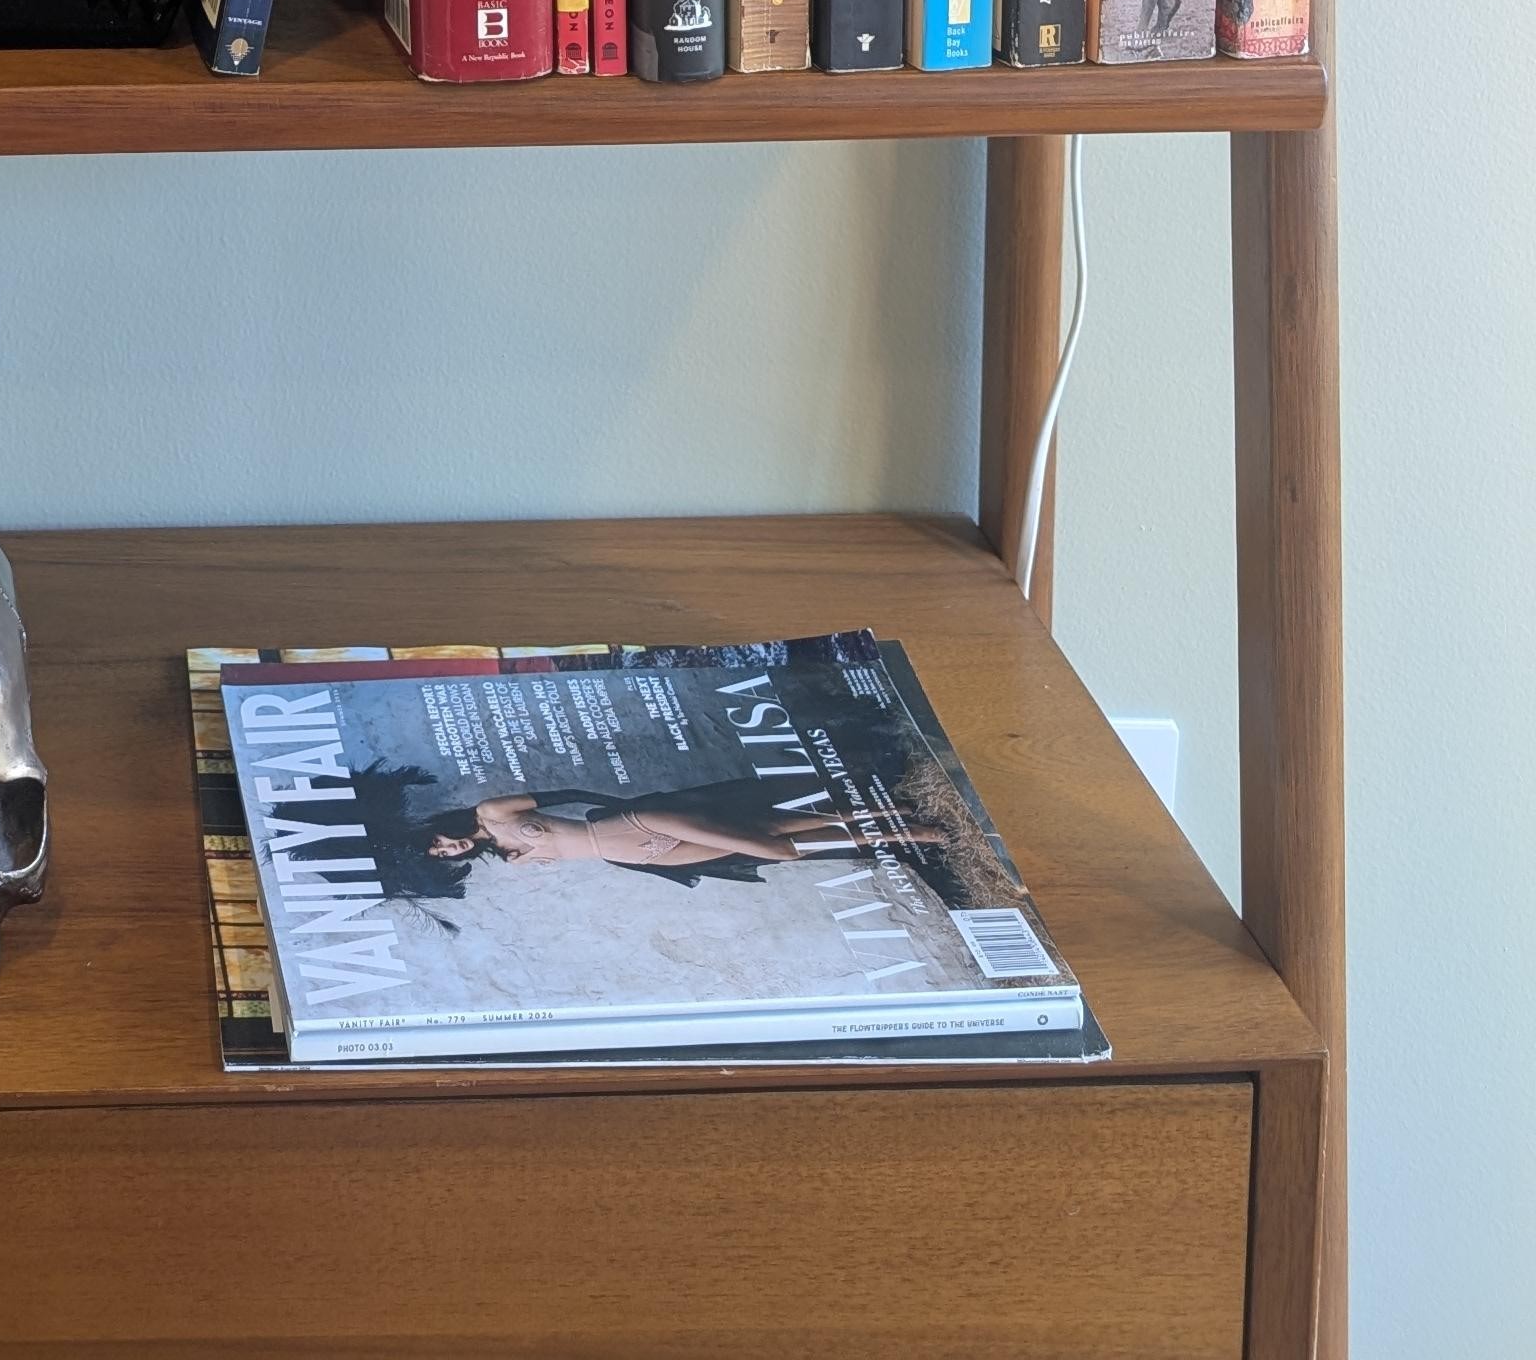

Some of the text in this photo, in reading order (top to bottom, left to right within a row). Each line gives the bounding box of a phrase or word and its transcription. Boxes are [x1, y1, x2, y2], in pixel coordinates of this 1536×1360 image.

[241, 690, 357, 803] FAIR
[264, 823, 412, 1006] VANITY
[482, 1012, 554, 1022] SUMMER 2026
